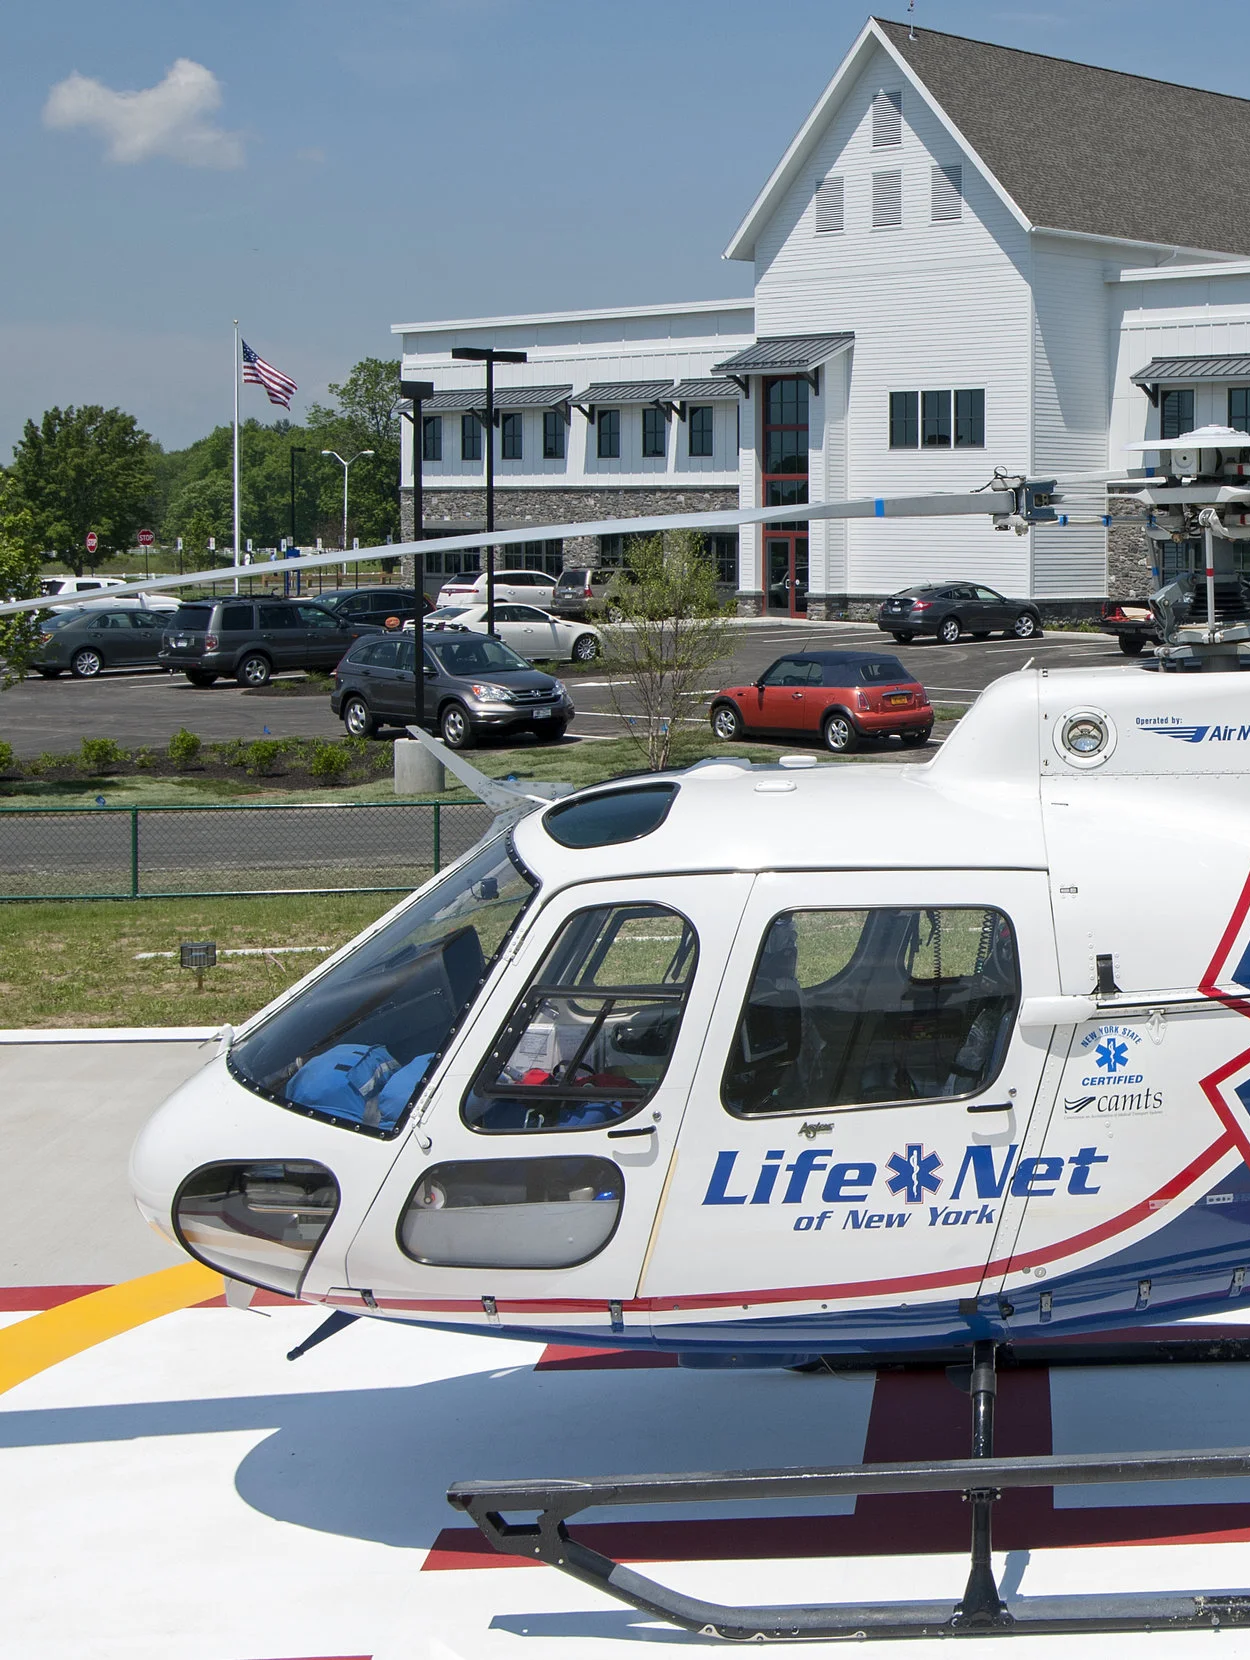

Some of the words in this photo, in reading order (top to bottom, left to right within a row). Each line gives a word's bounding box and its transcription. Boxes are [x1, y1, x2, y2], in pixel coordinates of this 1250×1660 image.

[1135, 716, 1169, 725] Operated
[1172, 716, 1183, 725] by:
[1208, 725, 1237, 741] Air
[1080, 1031, 1098, 1048] NEW
[1099, 1025, 1119, 1035] YORK
[1122, 1027, 1142, 1045] STATE
[1081, 1074, 1143, 1086] CERTIFIED
[1097, 1088, 1163, 1112] camts
[701, 1149, 877, 1205] Life
[949, 1144, 1109, 1200] Net
[793, 1209, 833, 1231] of
[842, 1209, 912, 1230] New
[928, 1204, 996, 1227] York
